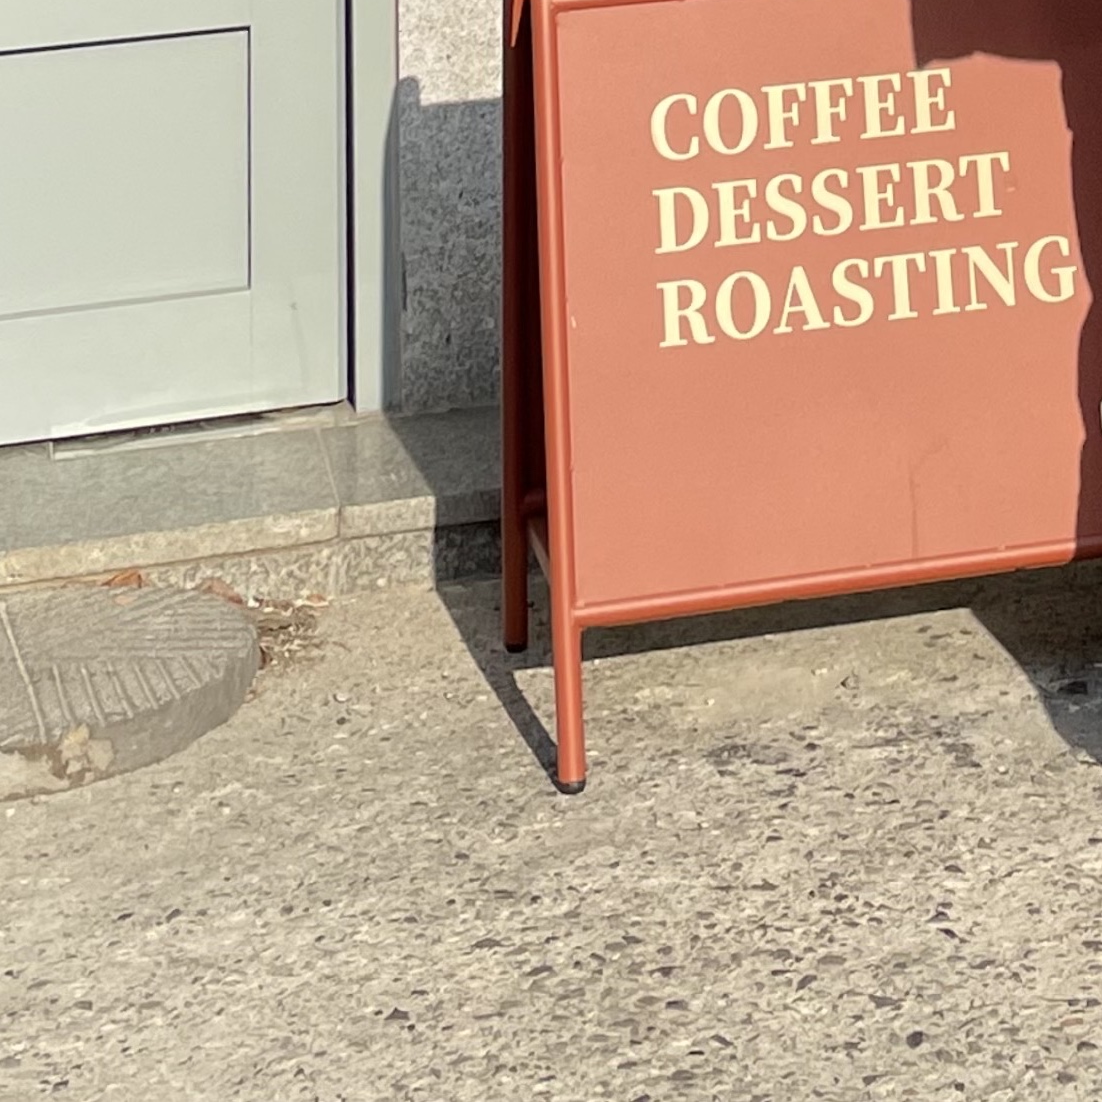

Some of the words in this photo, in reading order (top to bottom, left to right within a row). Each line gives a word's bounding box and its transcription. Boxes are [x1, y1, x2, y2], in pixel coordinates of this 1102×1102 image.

[650, 68, 956, 161] COFFEE
[652, 151, 1010, 254] DESSERT
[656, 235, 1077, 348] ROASTING
